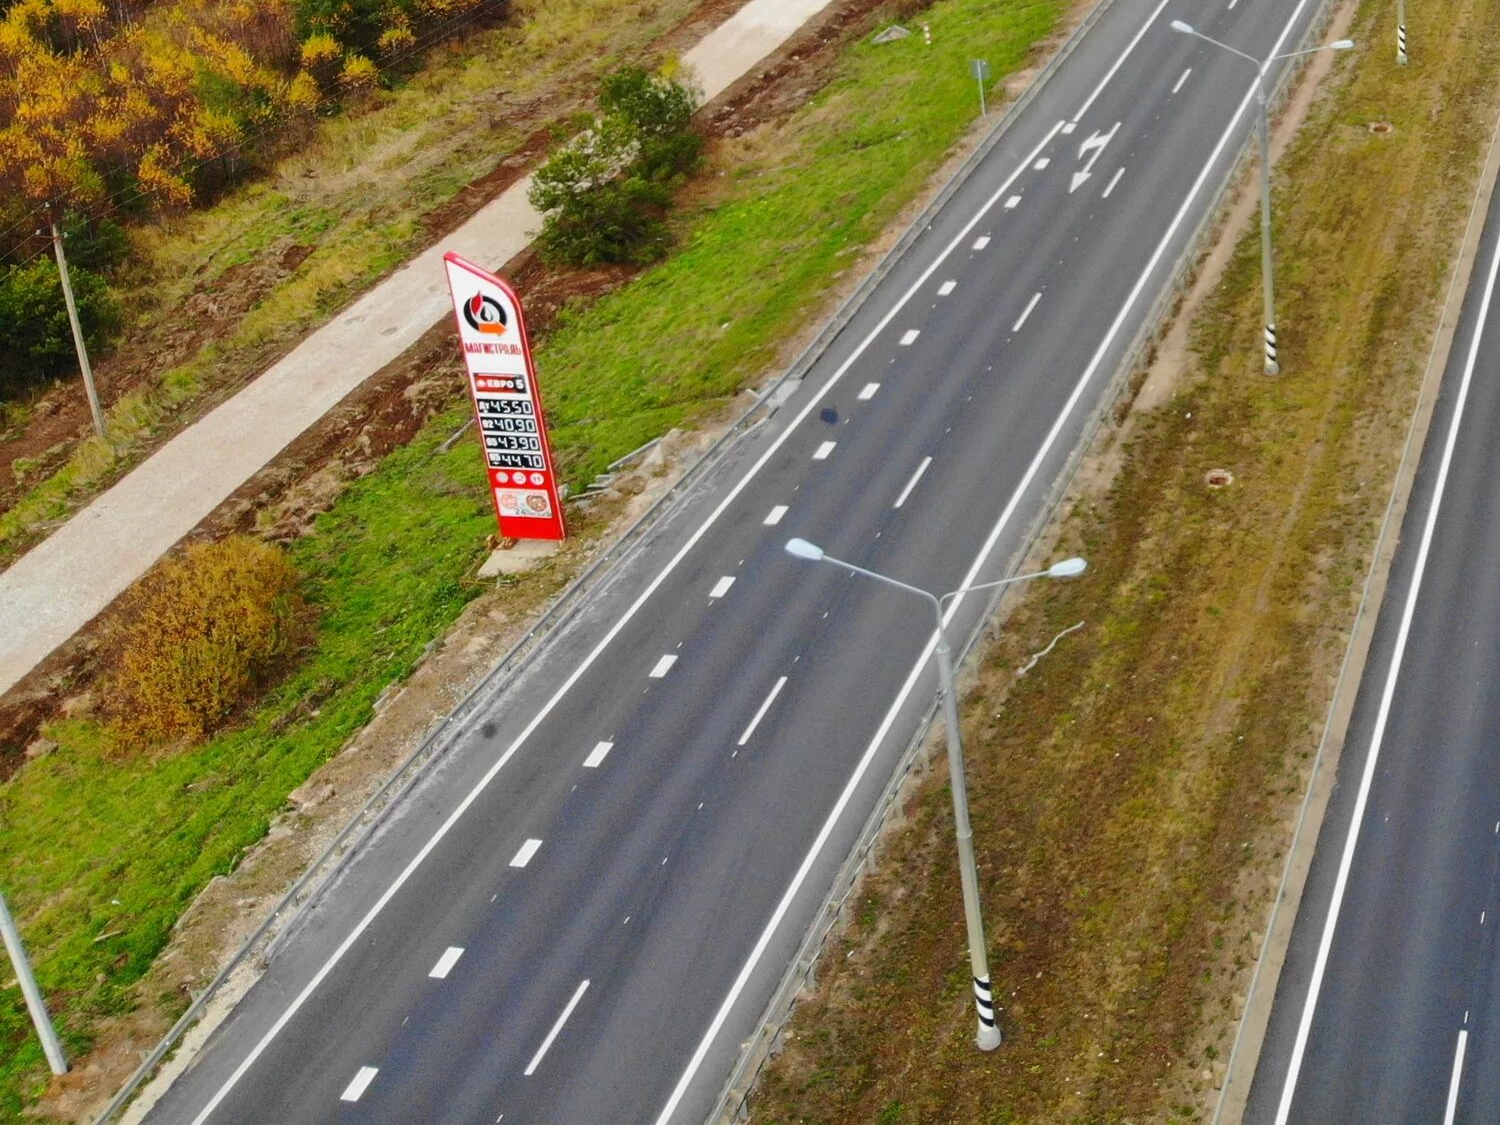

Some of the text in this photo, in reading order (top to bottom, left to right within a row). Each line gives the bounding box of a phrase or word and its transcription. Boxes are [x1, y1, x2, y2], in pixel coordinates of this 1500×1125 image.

[464, 342, 521, 355] МАГИСТРАЛЬ
[486, 379, 524, 389] ЕВРО 5
[482, 419, 494, 429] 92
